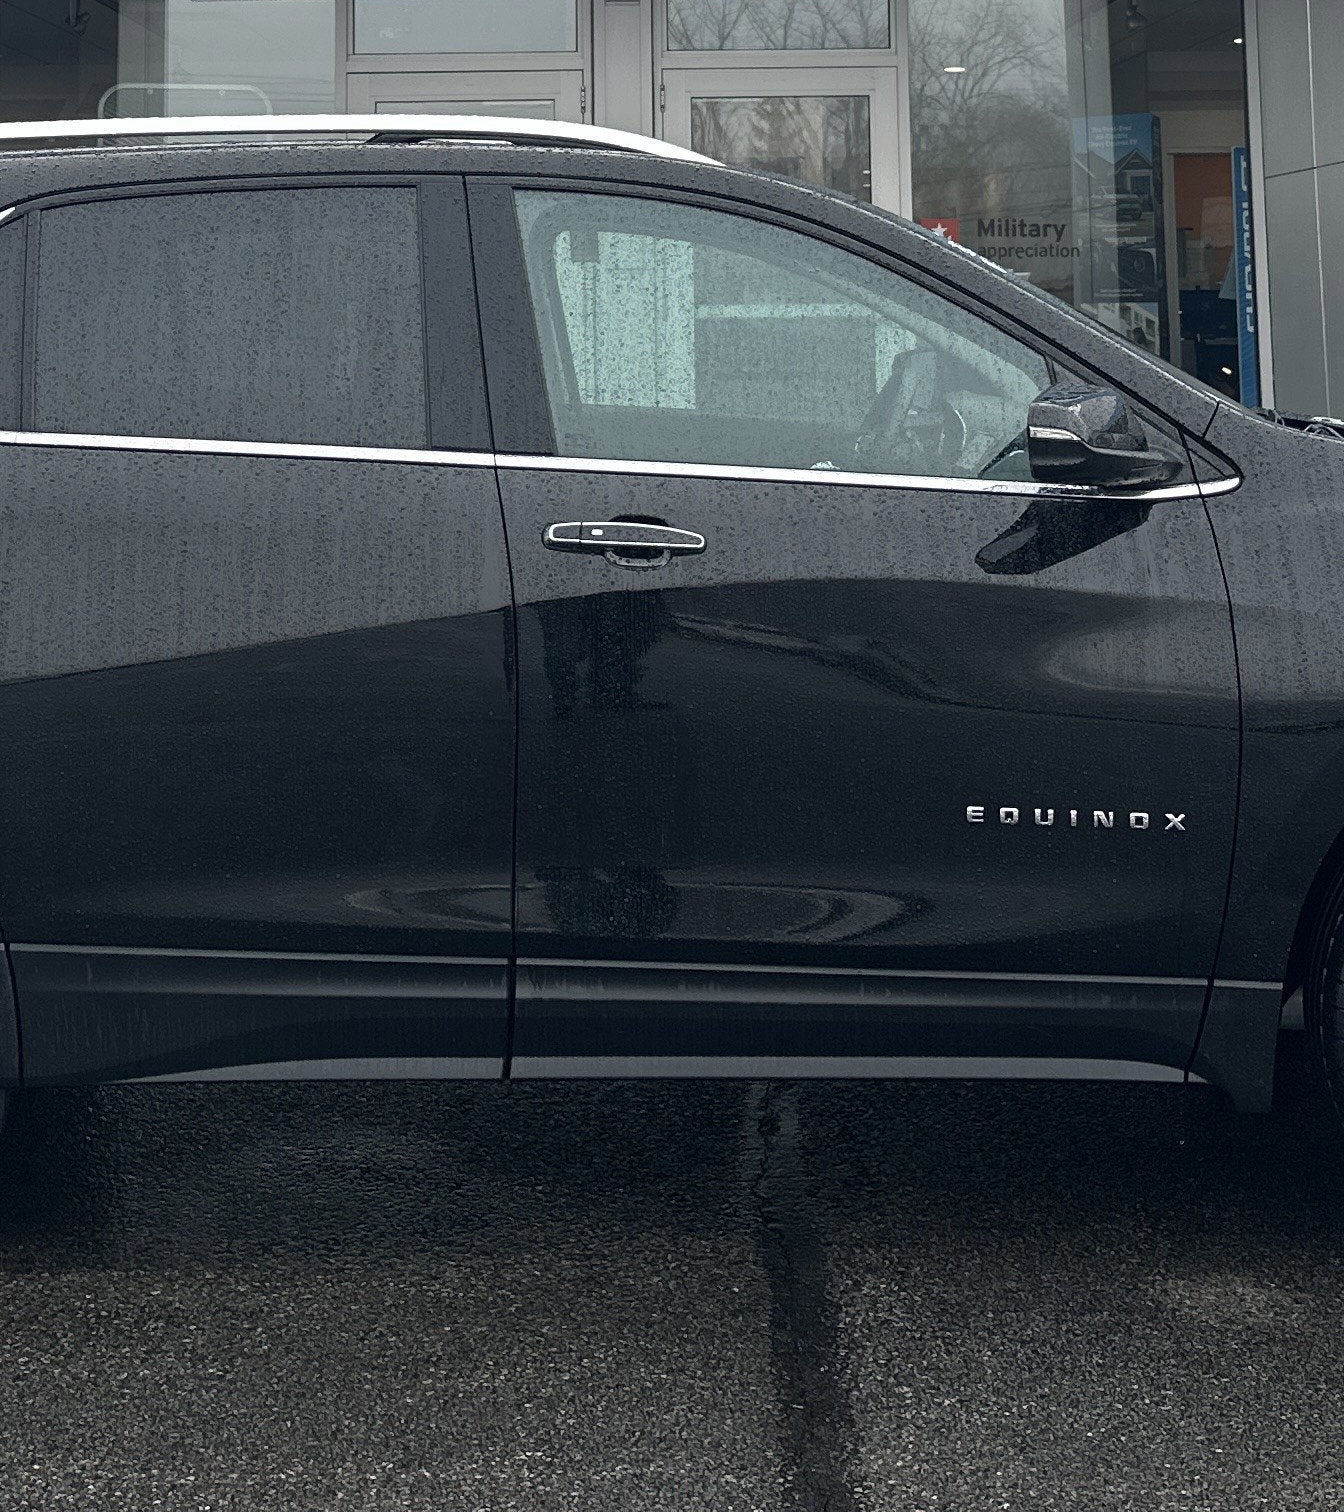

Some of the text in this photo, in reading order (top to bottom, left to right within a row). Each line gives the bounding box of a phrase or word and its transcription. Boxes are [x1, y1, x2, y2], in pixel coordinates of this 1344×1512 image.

[978, 218, 1066, 242] Military
[978, 243, 1080, 261] appreciation
[966, 805, 1186, 831] EQUINOX
